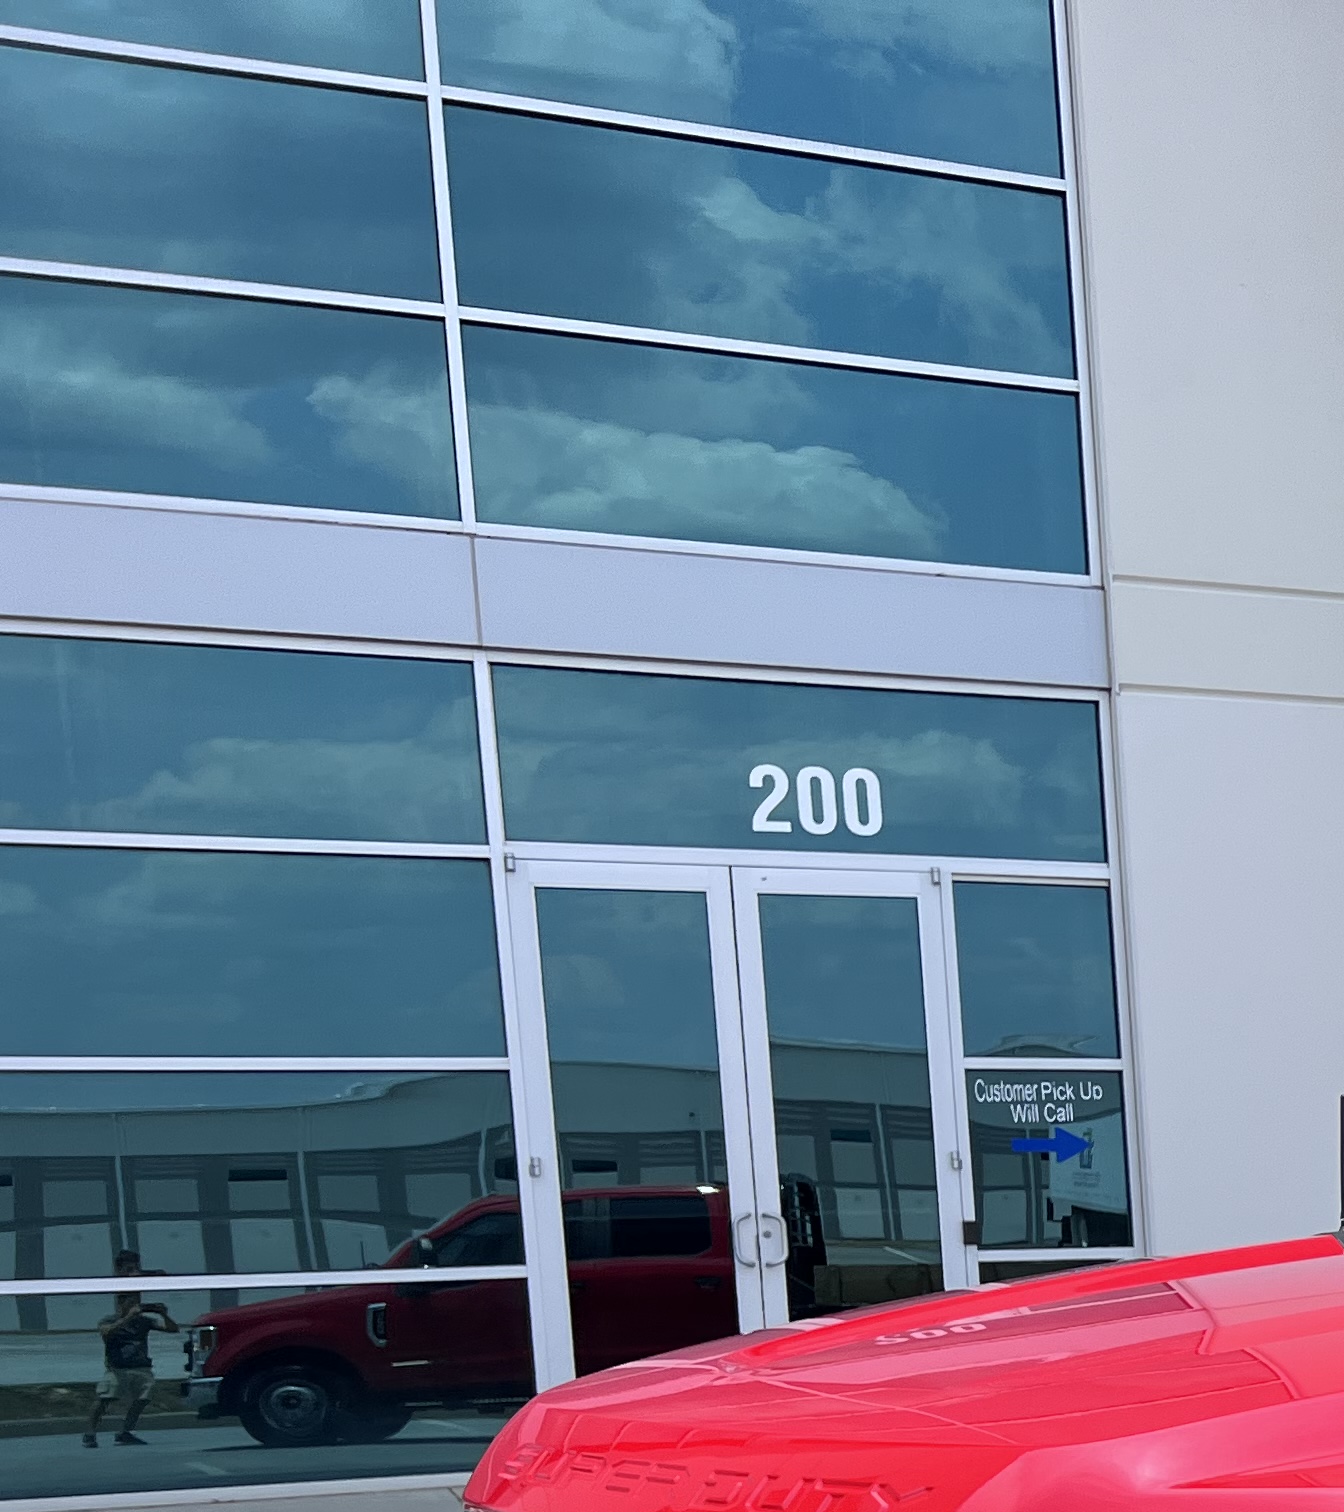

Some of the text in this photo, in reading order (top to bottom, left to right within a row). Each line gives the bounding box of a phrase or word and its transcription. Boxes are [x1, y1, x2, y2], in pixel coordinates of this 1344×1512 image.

[749, 764, 883, 837] 200
[974, 1079, 1103, 1103] Customer Pick Up
[1010, 1103, 1074, 1124] Will Call
